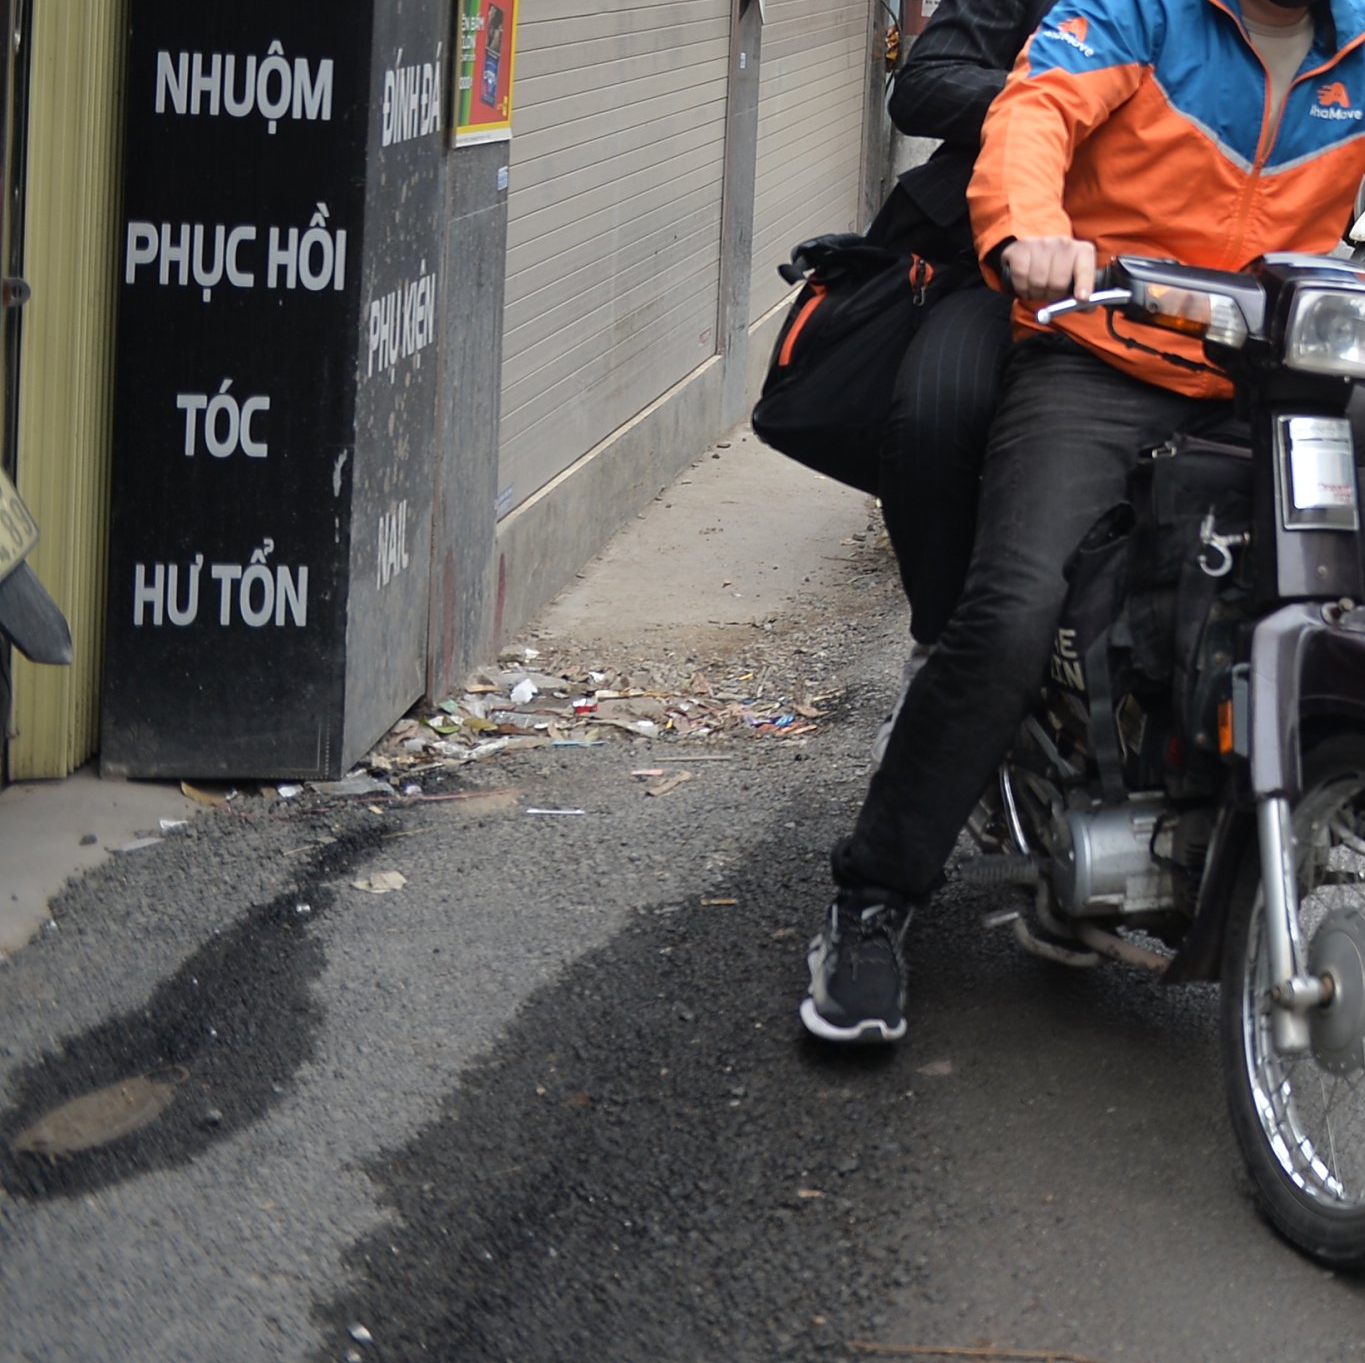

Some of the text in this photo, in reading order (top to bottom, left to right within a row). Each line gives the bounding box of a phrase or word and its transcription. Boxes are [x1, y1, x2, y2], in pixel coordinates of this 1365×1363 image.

[155, 39, 334, 134] NHUỘM
[125, 202, 346, 302] PHỤC HỒI
[177, 378, 270, 458] TÓC
[133, 538, 308, 627] HƯ TỔN
[376, 500, 408, 590] NAIL
